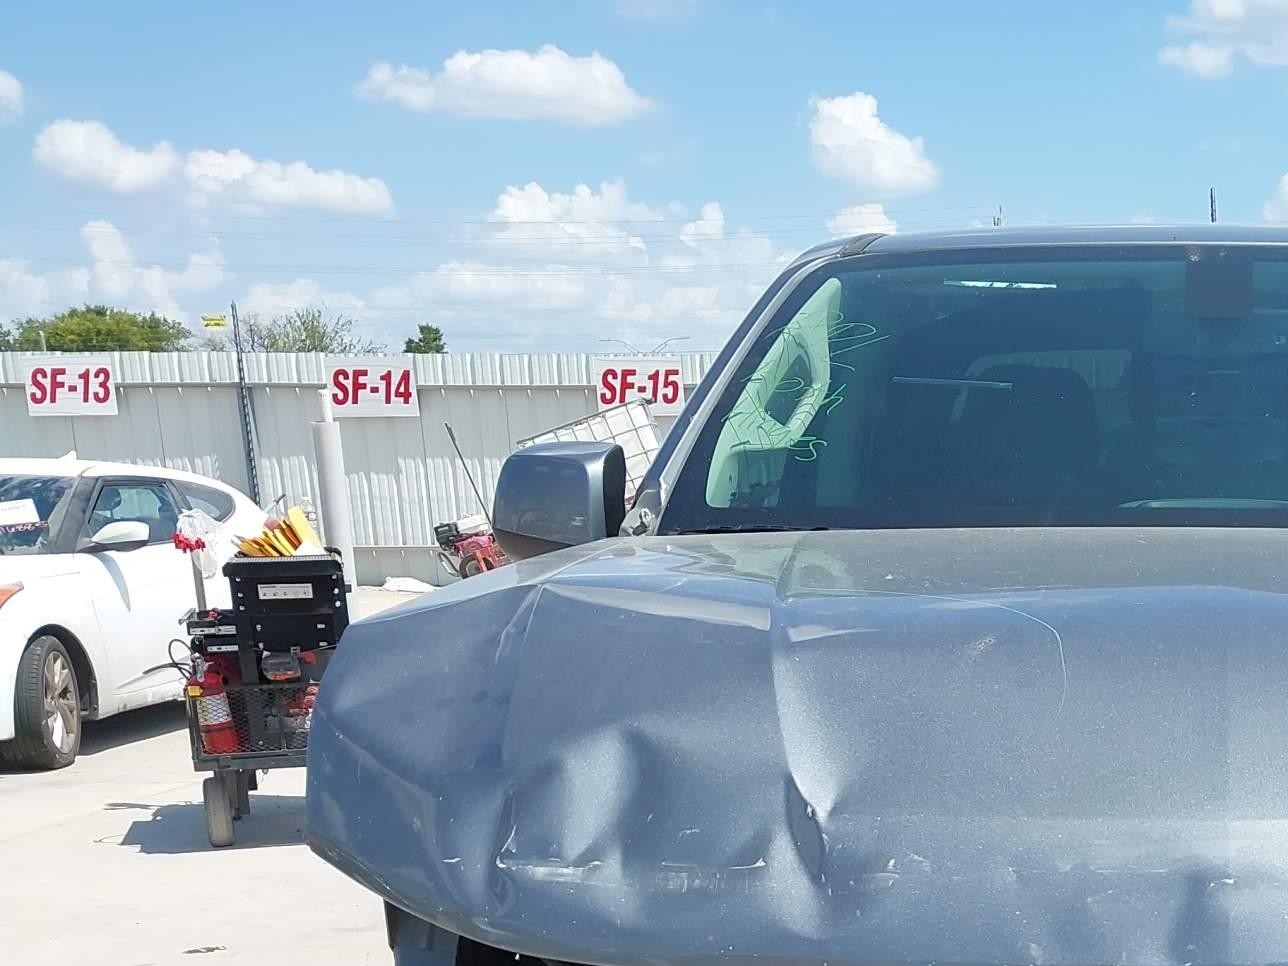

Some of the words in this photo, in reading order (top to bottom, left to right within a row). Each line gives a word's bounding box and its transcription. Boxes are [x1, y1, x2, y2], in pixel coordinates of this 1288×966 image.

[30, 367, 111, 405] SF-13
[331, 368, 413, 406] SF-14
[599, 368, 680, 405] SF-15
